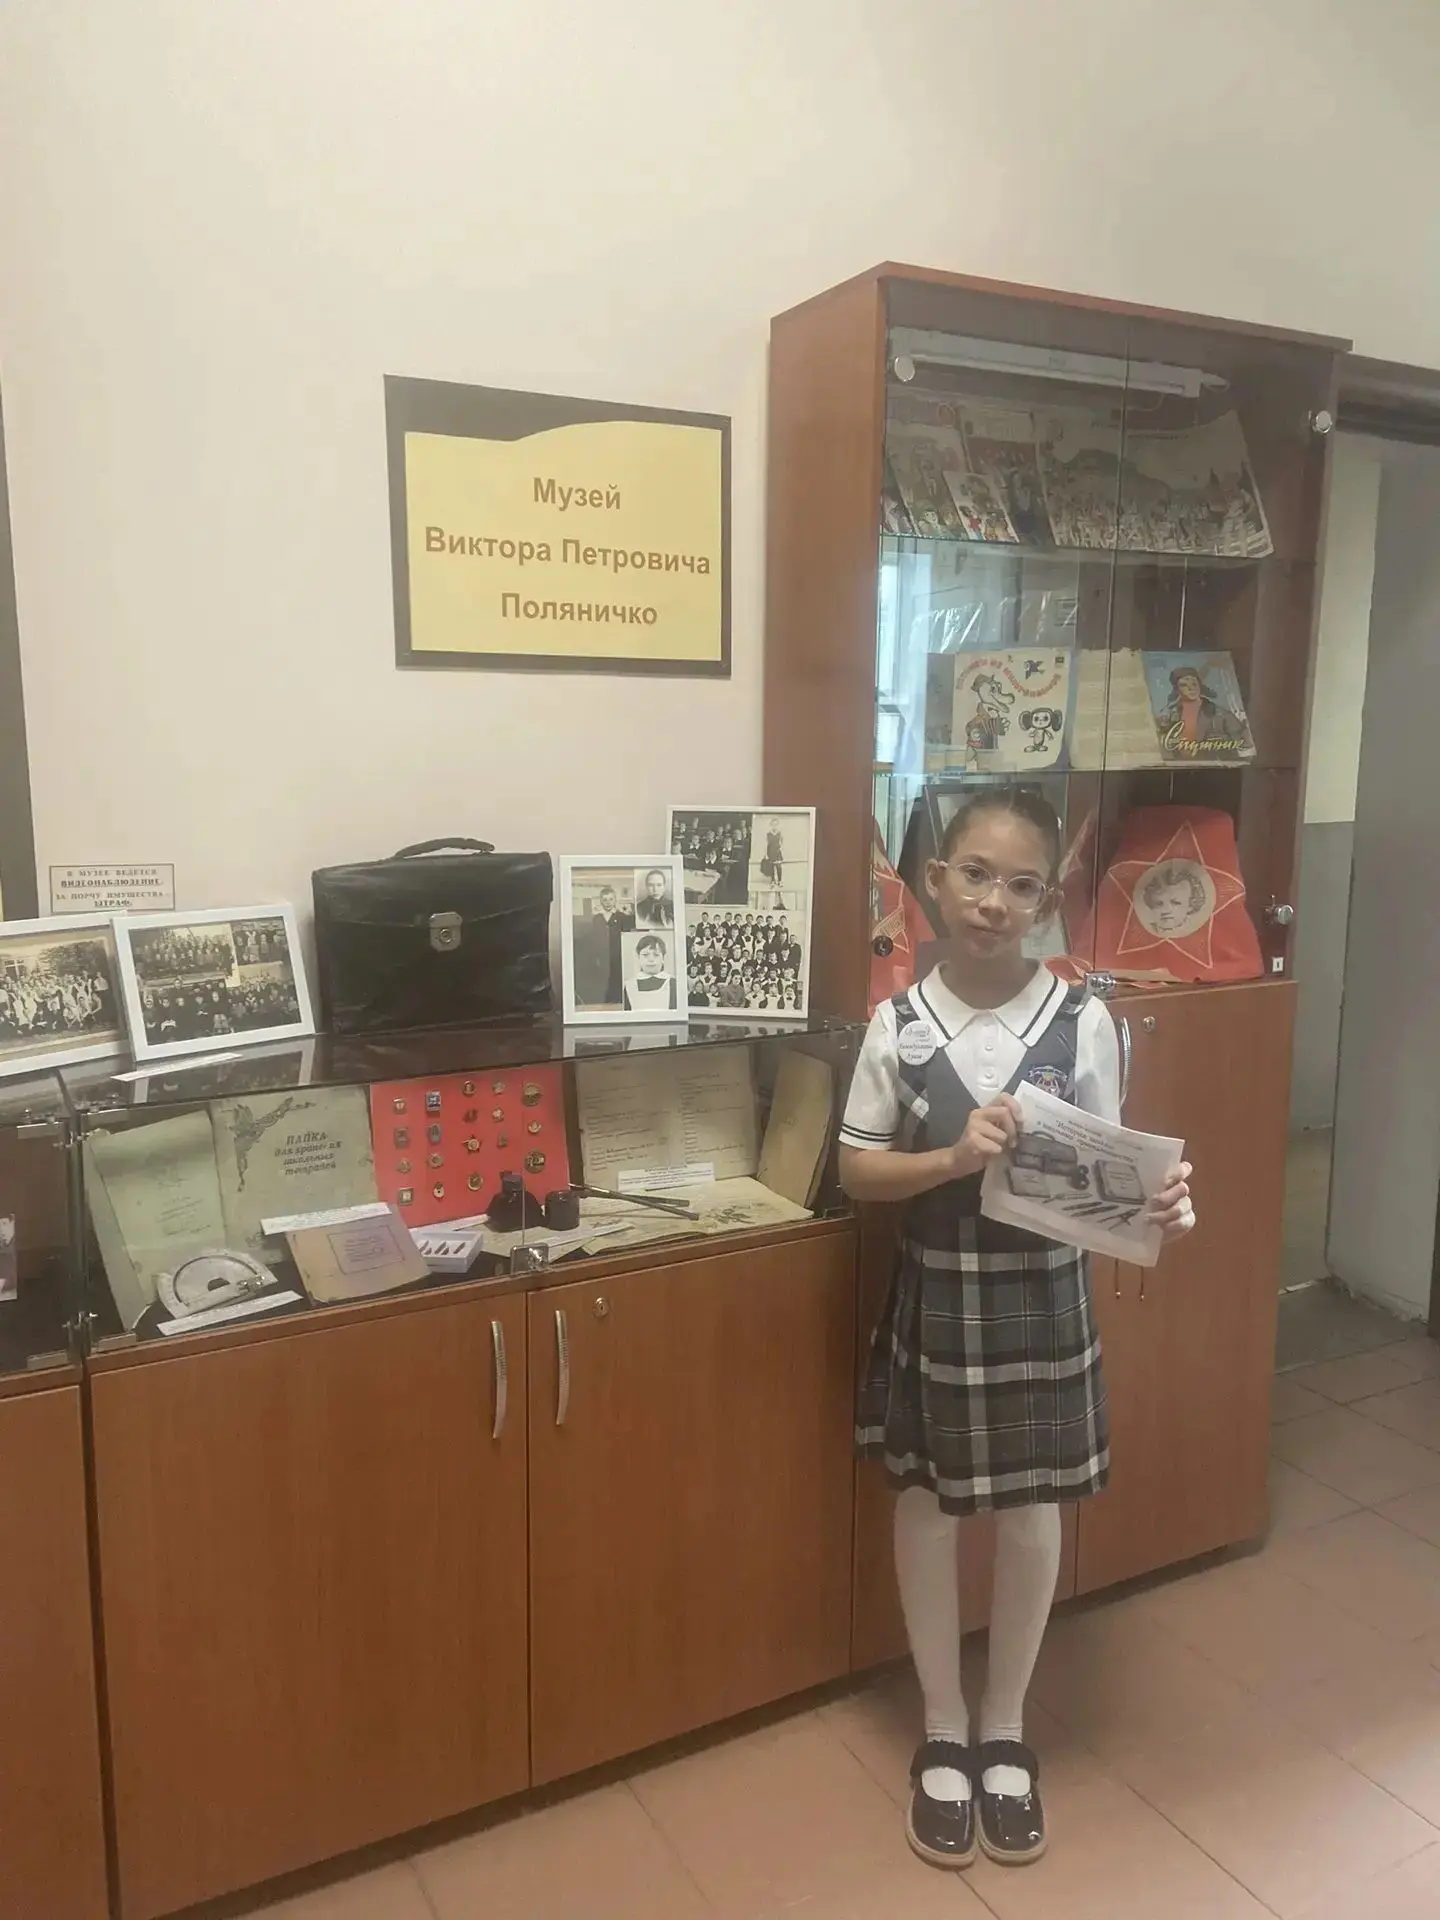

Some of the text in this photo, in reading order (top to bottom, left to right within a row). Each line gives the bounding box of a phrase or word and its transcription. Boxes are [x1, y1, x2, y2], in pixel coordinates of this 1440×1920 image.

[533, 477, 621, 511] Музей
[425, 526, 710, 574] Виктора Петровича
[501, 592, 657, 625] Поляничко
[1164, 720, 1245, 757] Спутник
[107, 891, 163, 899] ИМУЩЕСТВА
[286, 1131, 327, 1145] ПАПКА
